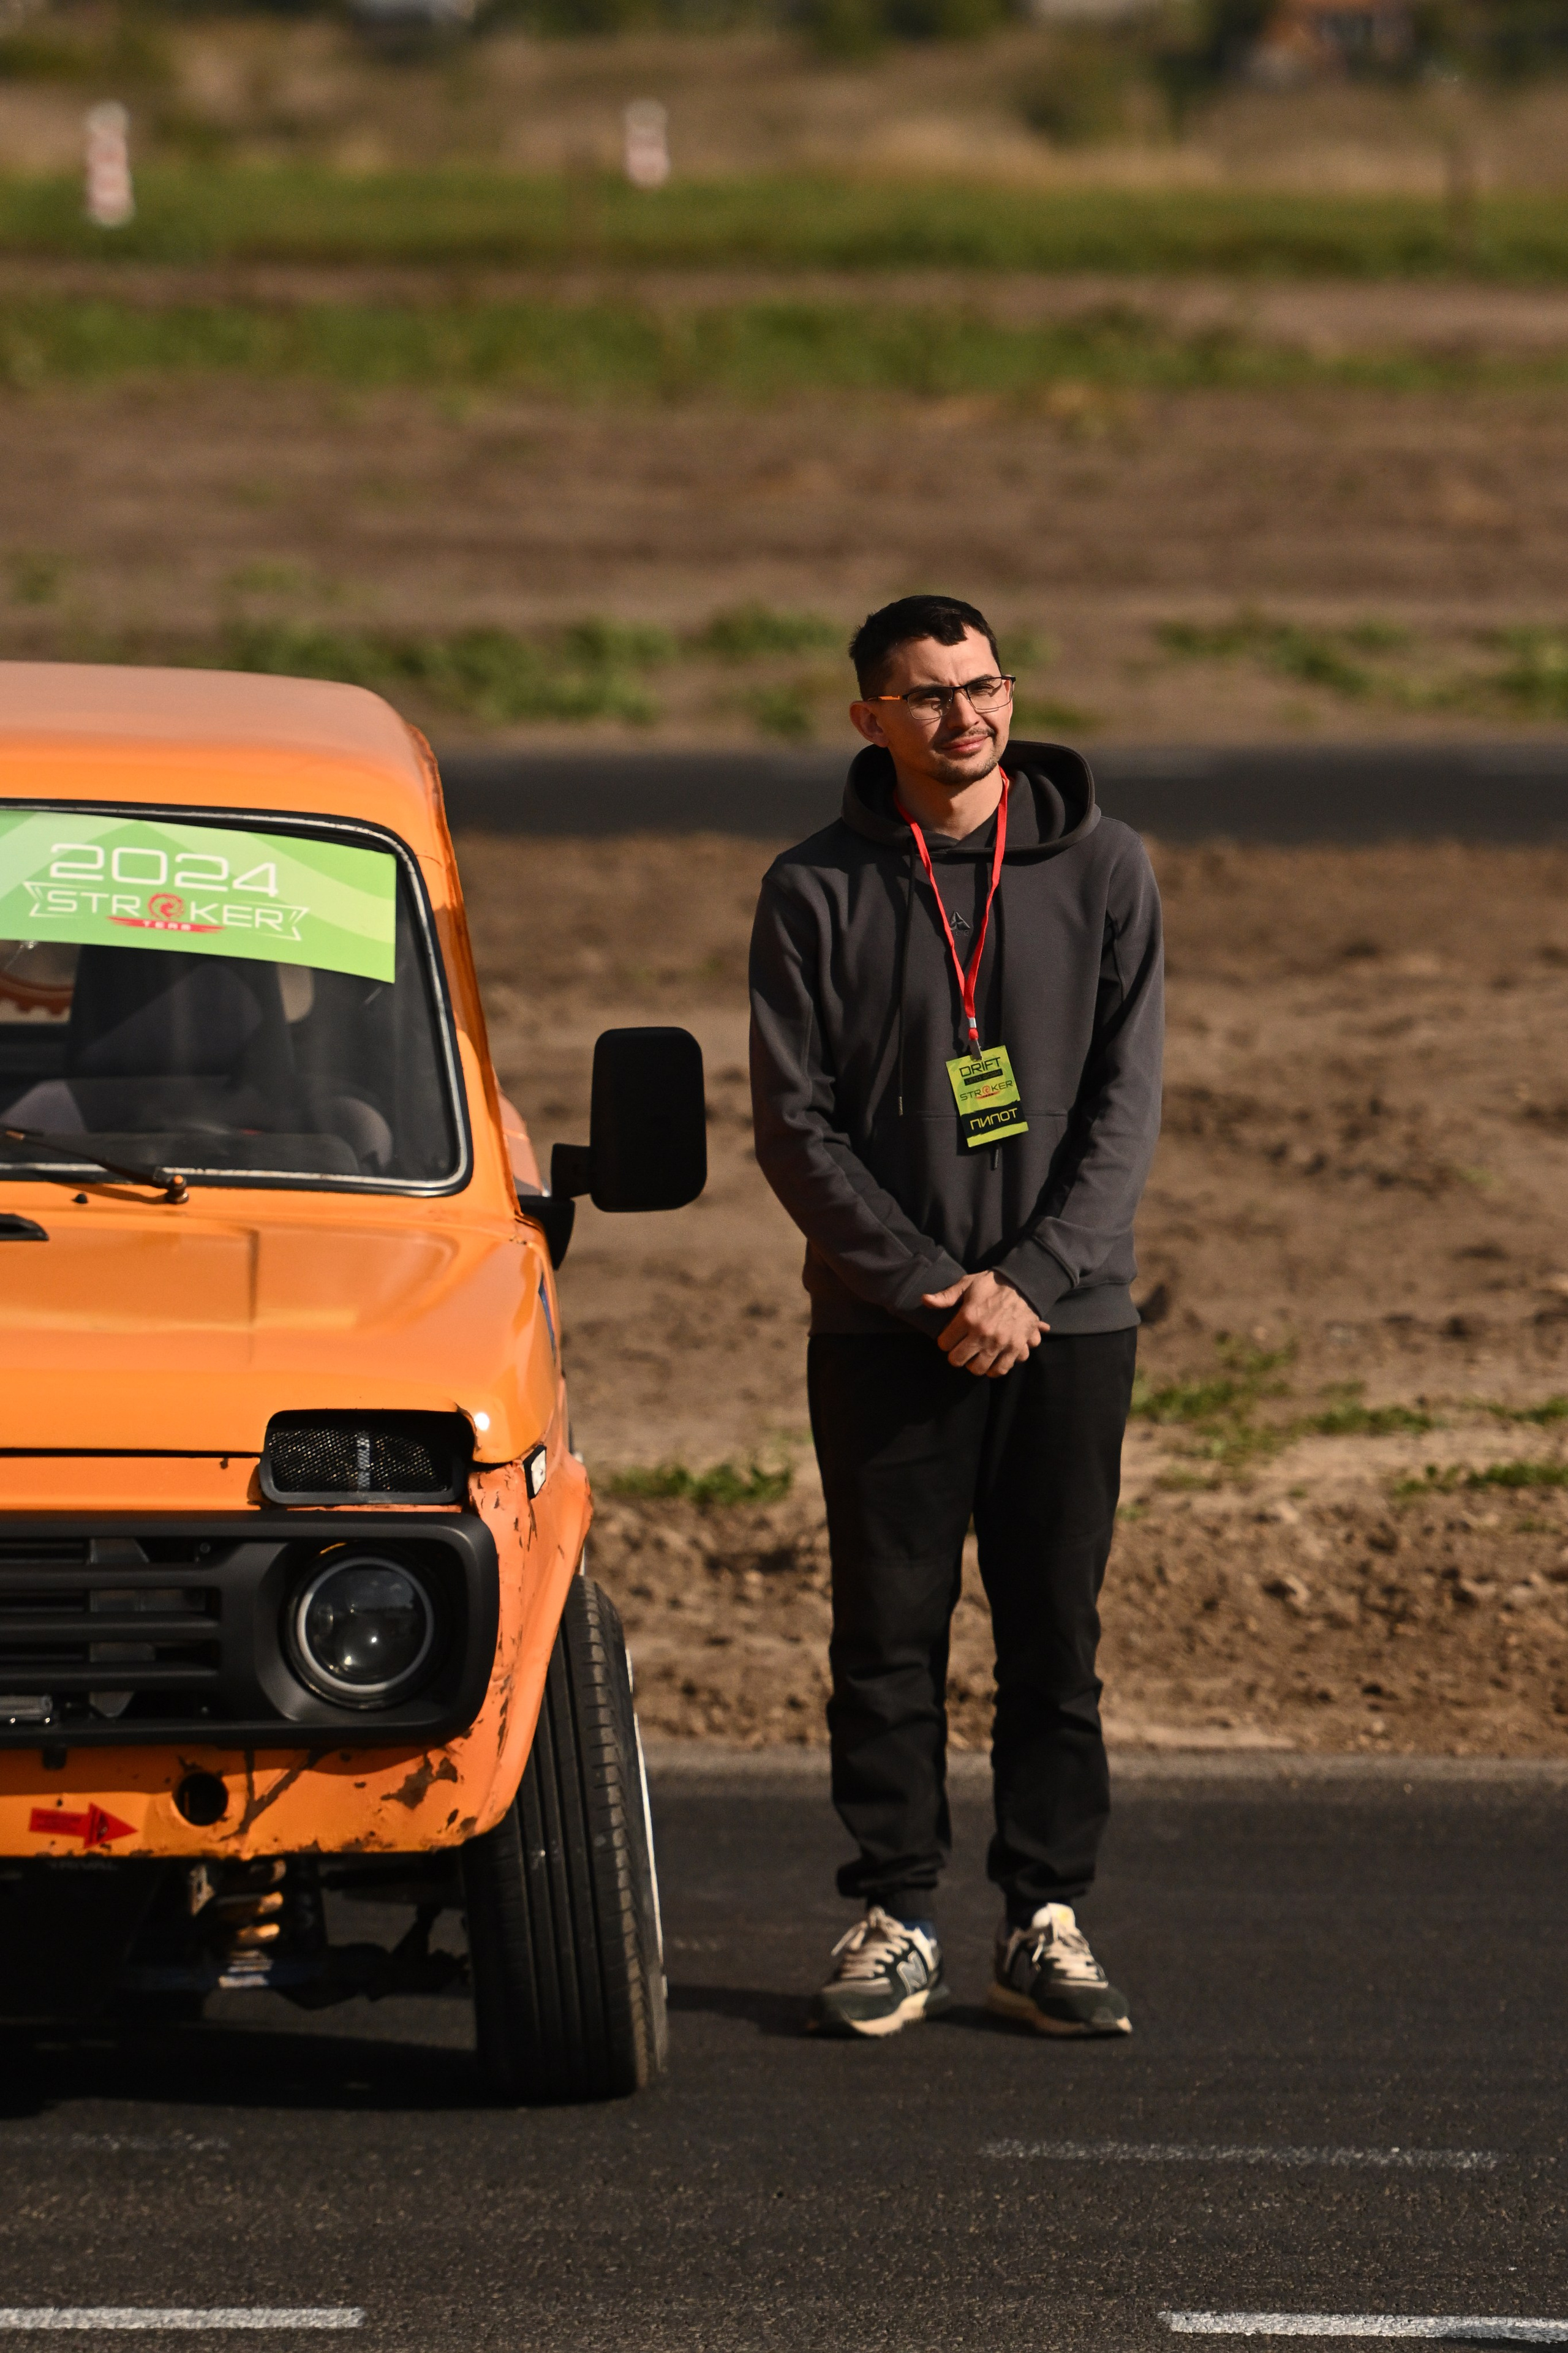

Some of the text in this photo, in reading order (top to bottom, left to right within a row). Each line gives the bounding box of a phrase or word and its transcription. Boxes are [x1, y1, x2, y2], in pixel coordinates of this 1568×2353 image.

[50, 843, 279, 897] 2024
[48, 890, 284, 932] STROKER
[959, 1057, 1000, 1077] DRIFT
[960, 1080, 1013, 1101] STROKER
